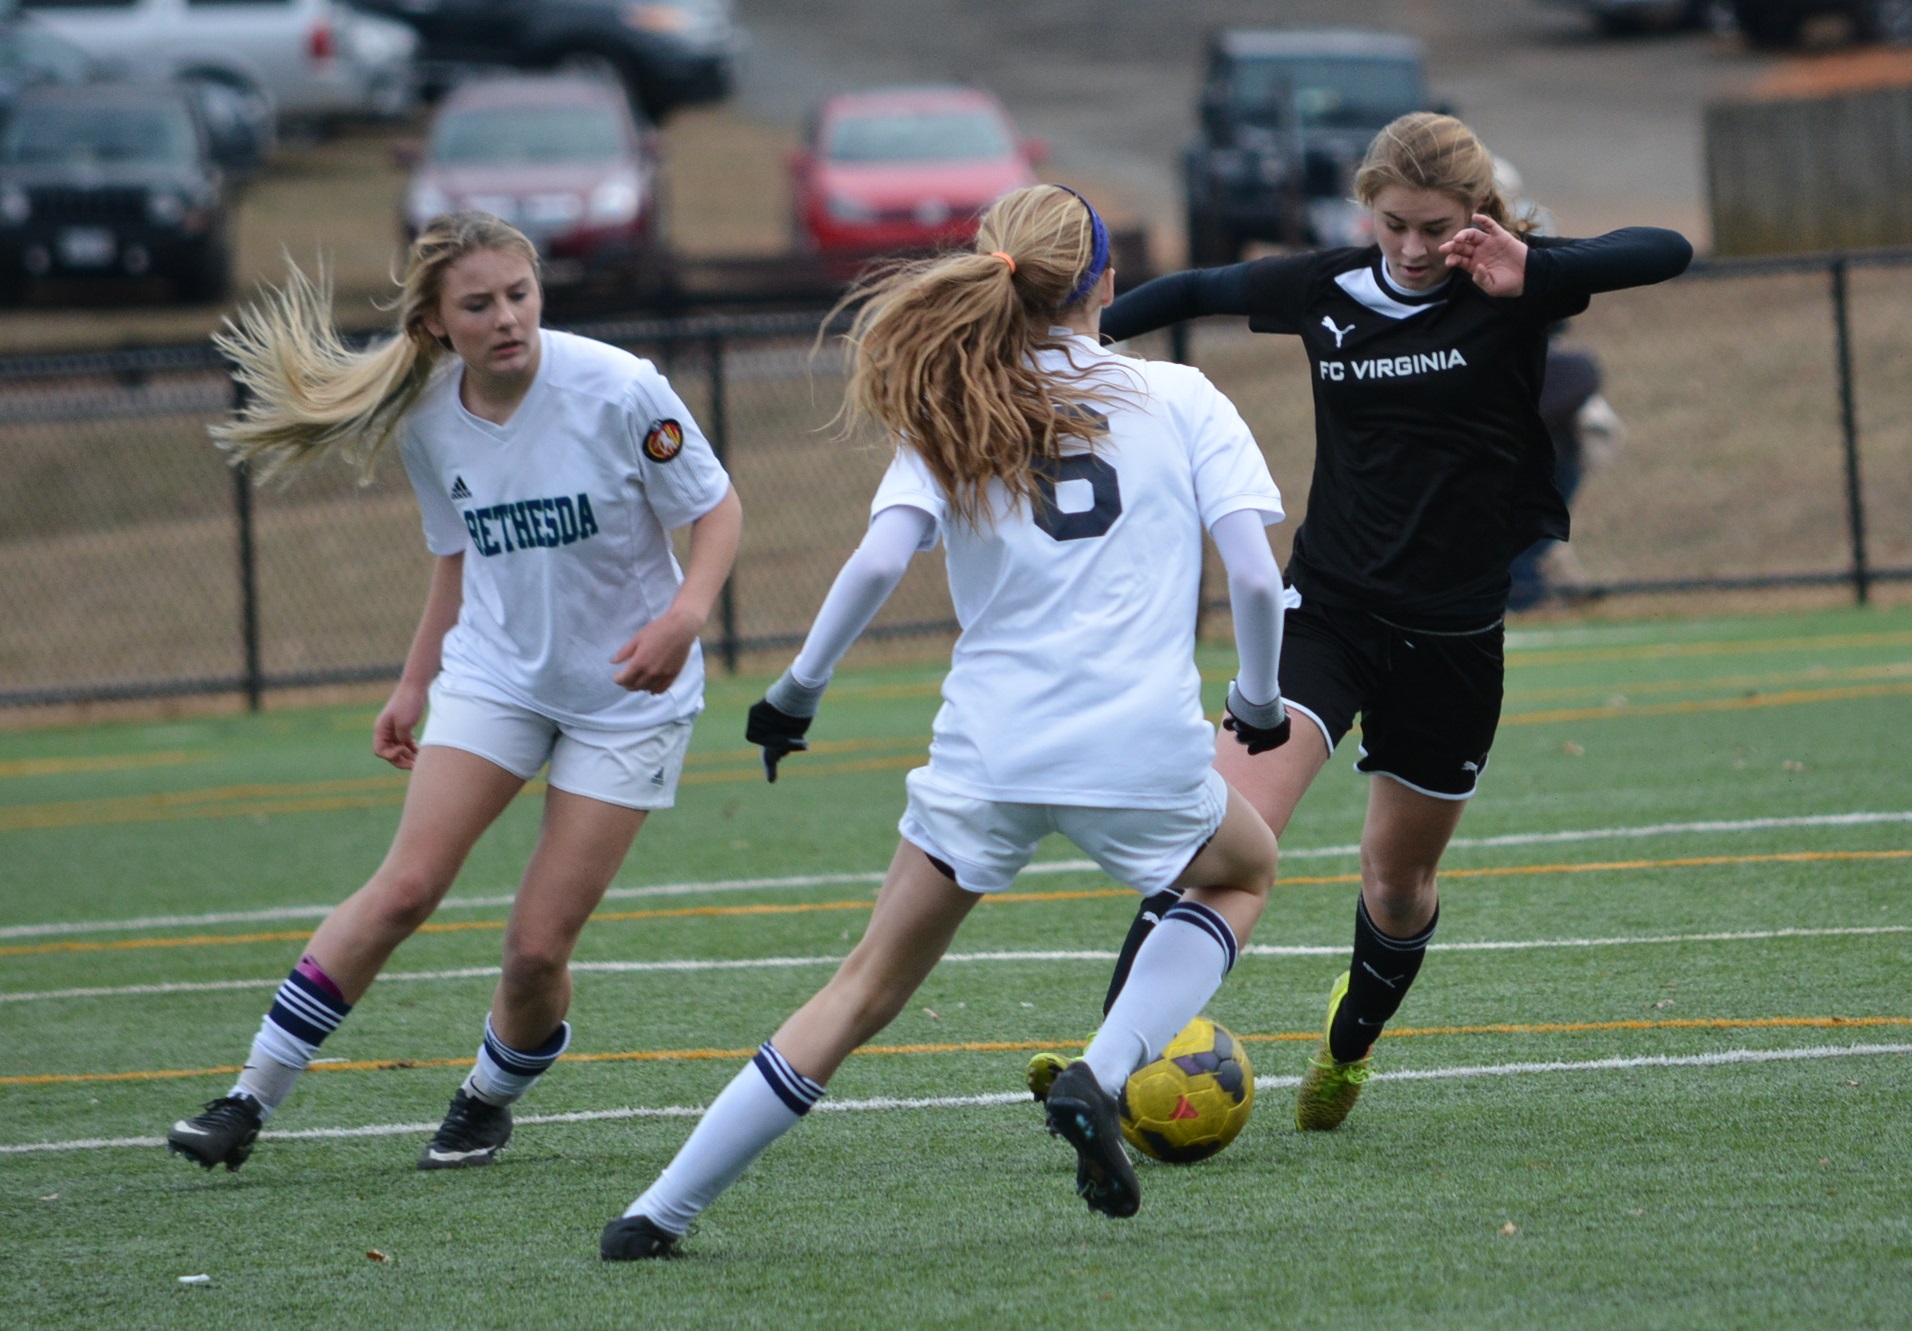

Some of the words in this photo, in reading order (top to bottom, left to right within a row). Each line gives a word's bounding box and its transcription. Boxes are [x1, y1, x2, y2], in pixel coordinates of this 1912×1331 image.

[1320, 360, 1345, 381] FC
[1351, 348, 1467, 380] VIRGINIA
[1028, 403, 1123, 541] 6
[464, 493, 598, 556] BETHESDA
